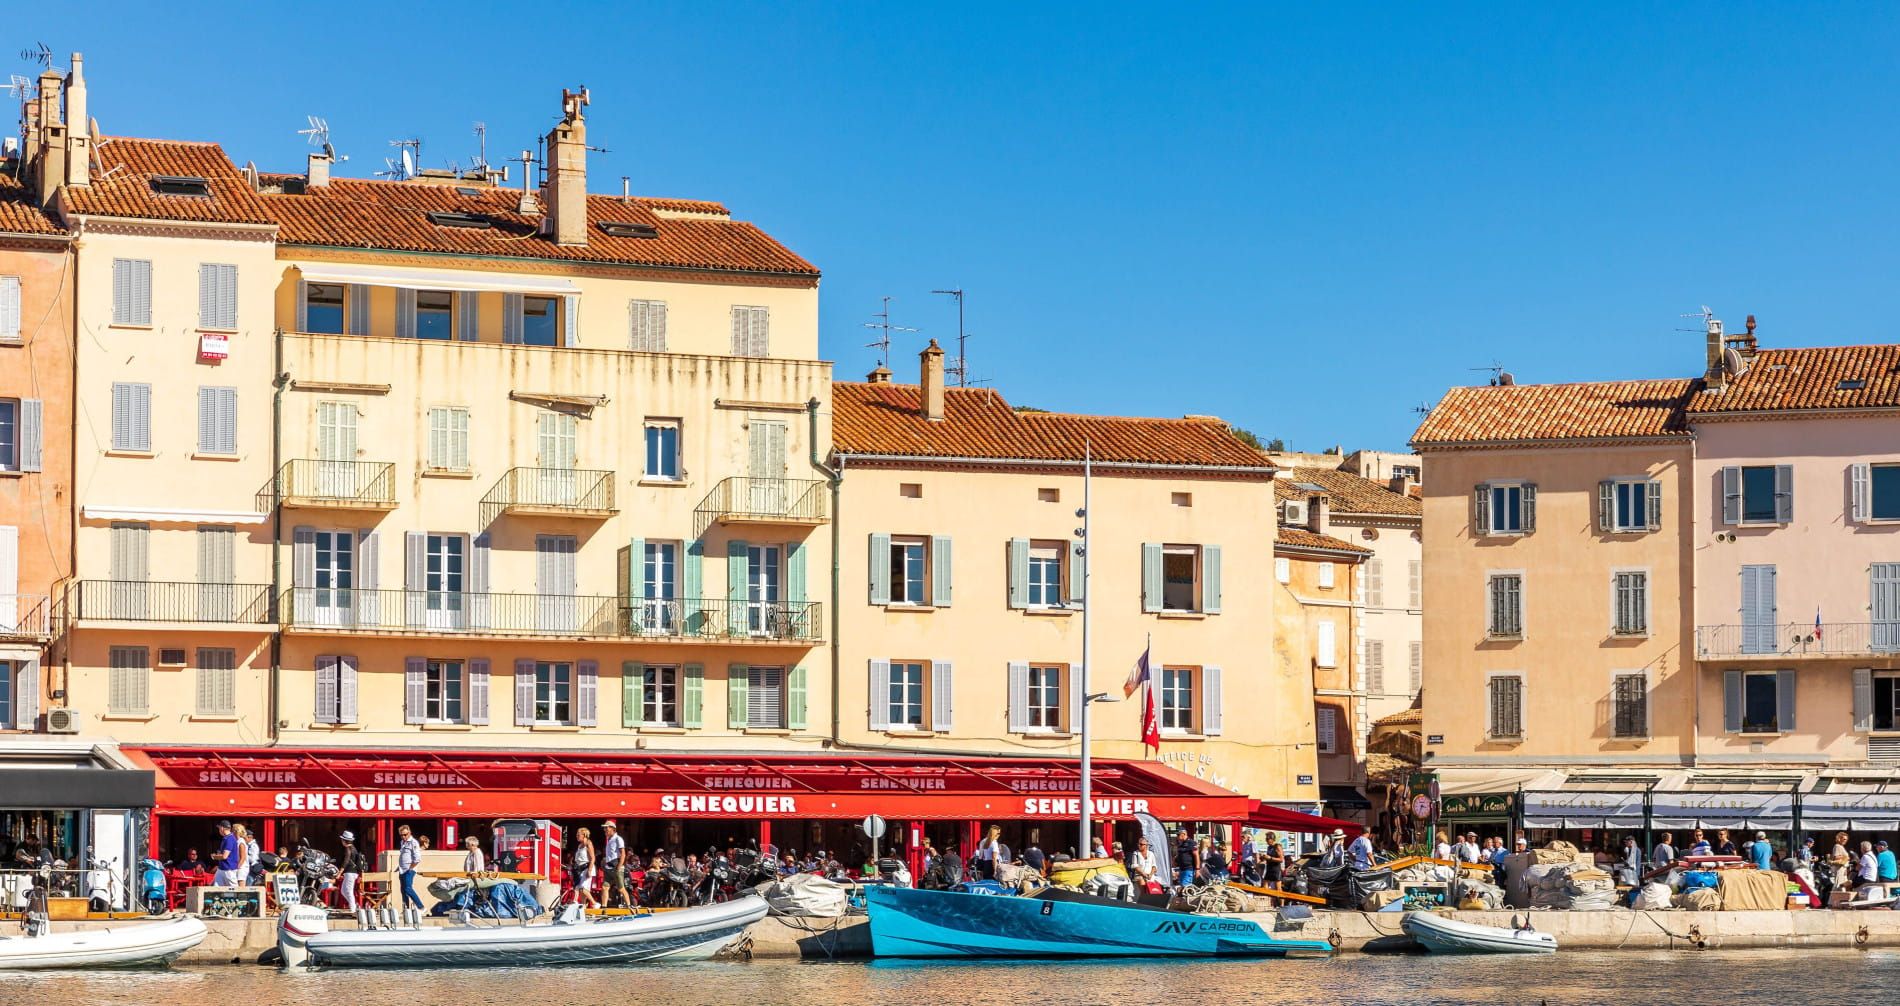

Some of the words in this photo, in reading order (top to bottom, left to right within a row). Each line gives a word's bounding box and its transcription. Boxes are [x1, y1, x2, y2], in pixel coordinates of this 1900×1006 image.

[1199, 754, 1213, 766] DE
[704, 777, 792, 788] SENEQUIER
[1012, 780, 1093, 791] SENEQUIE
[274, 792, 421, 811] SENEQUIER
[661, 795, 796, 812] SENEQUIER
[1043, 906, 1050, 914] 8
[1199, 922, 1256, 932] CARBON
